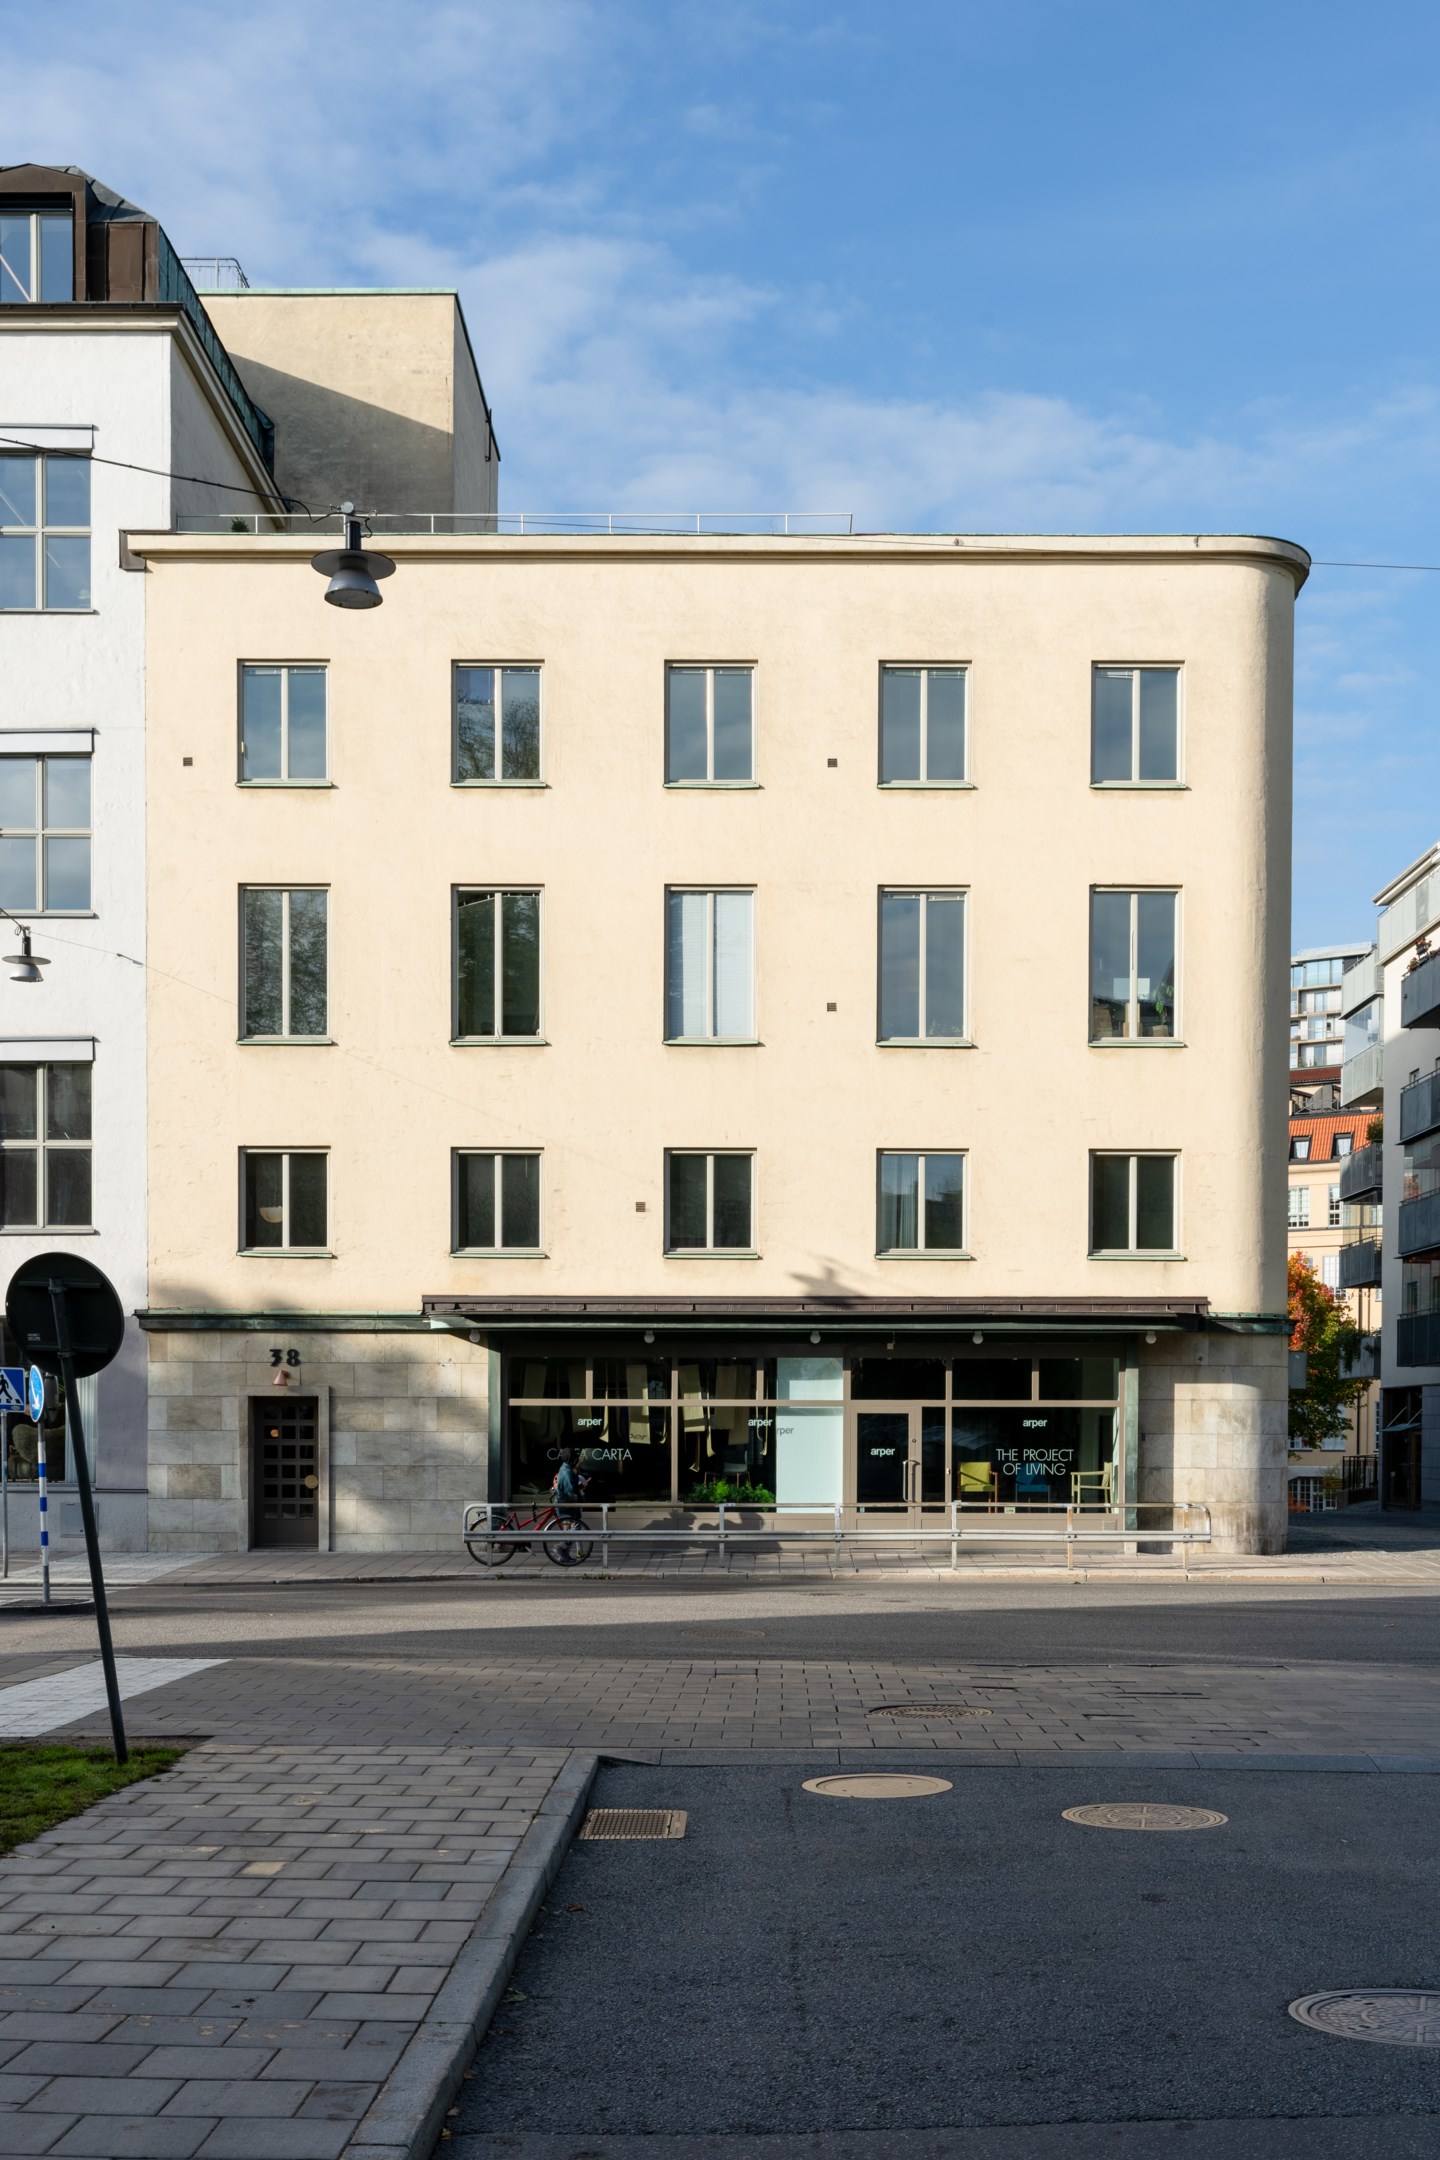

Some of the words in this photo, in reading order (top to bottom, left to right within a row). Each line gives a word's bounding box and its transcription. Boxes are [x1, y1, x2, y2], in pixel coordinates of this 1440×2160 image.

[269, 1349, 301, 1367] 38
[577, 1418, 602, 1427] arper
[748, 1419, 773, 1428] arper
[1022, 1419, 1048, 1429] arper
[592, 1448, 633, 1460] CARTA
[870, 1448, 896, 1458] arper
[995, 1448, 1018, 1461] THE
[1023, 1448, 1074, 1461] PROJECT
[1003, 1462, 1021, 1475] OF
[1026, 1462, 1066, 1475] LIVING
